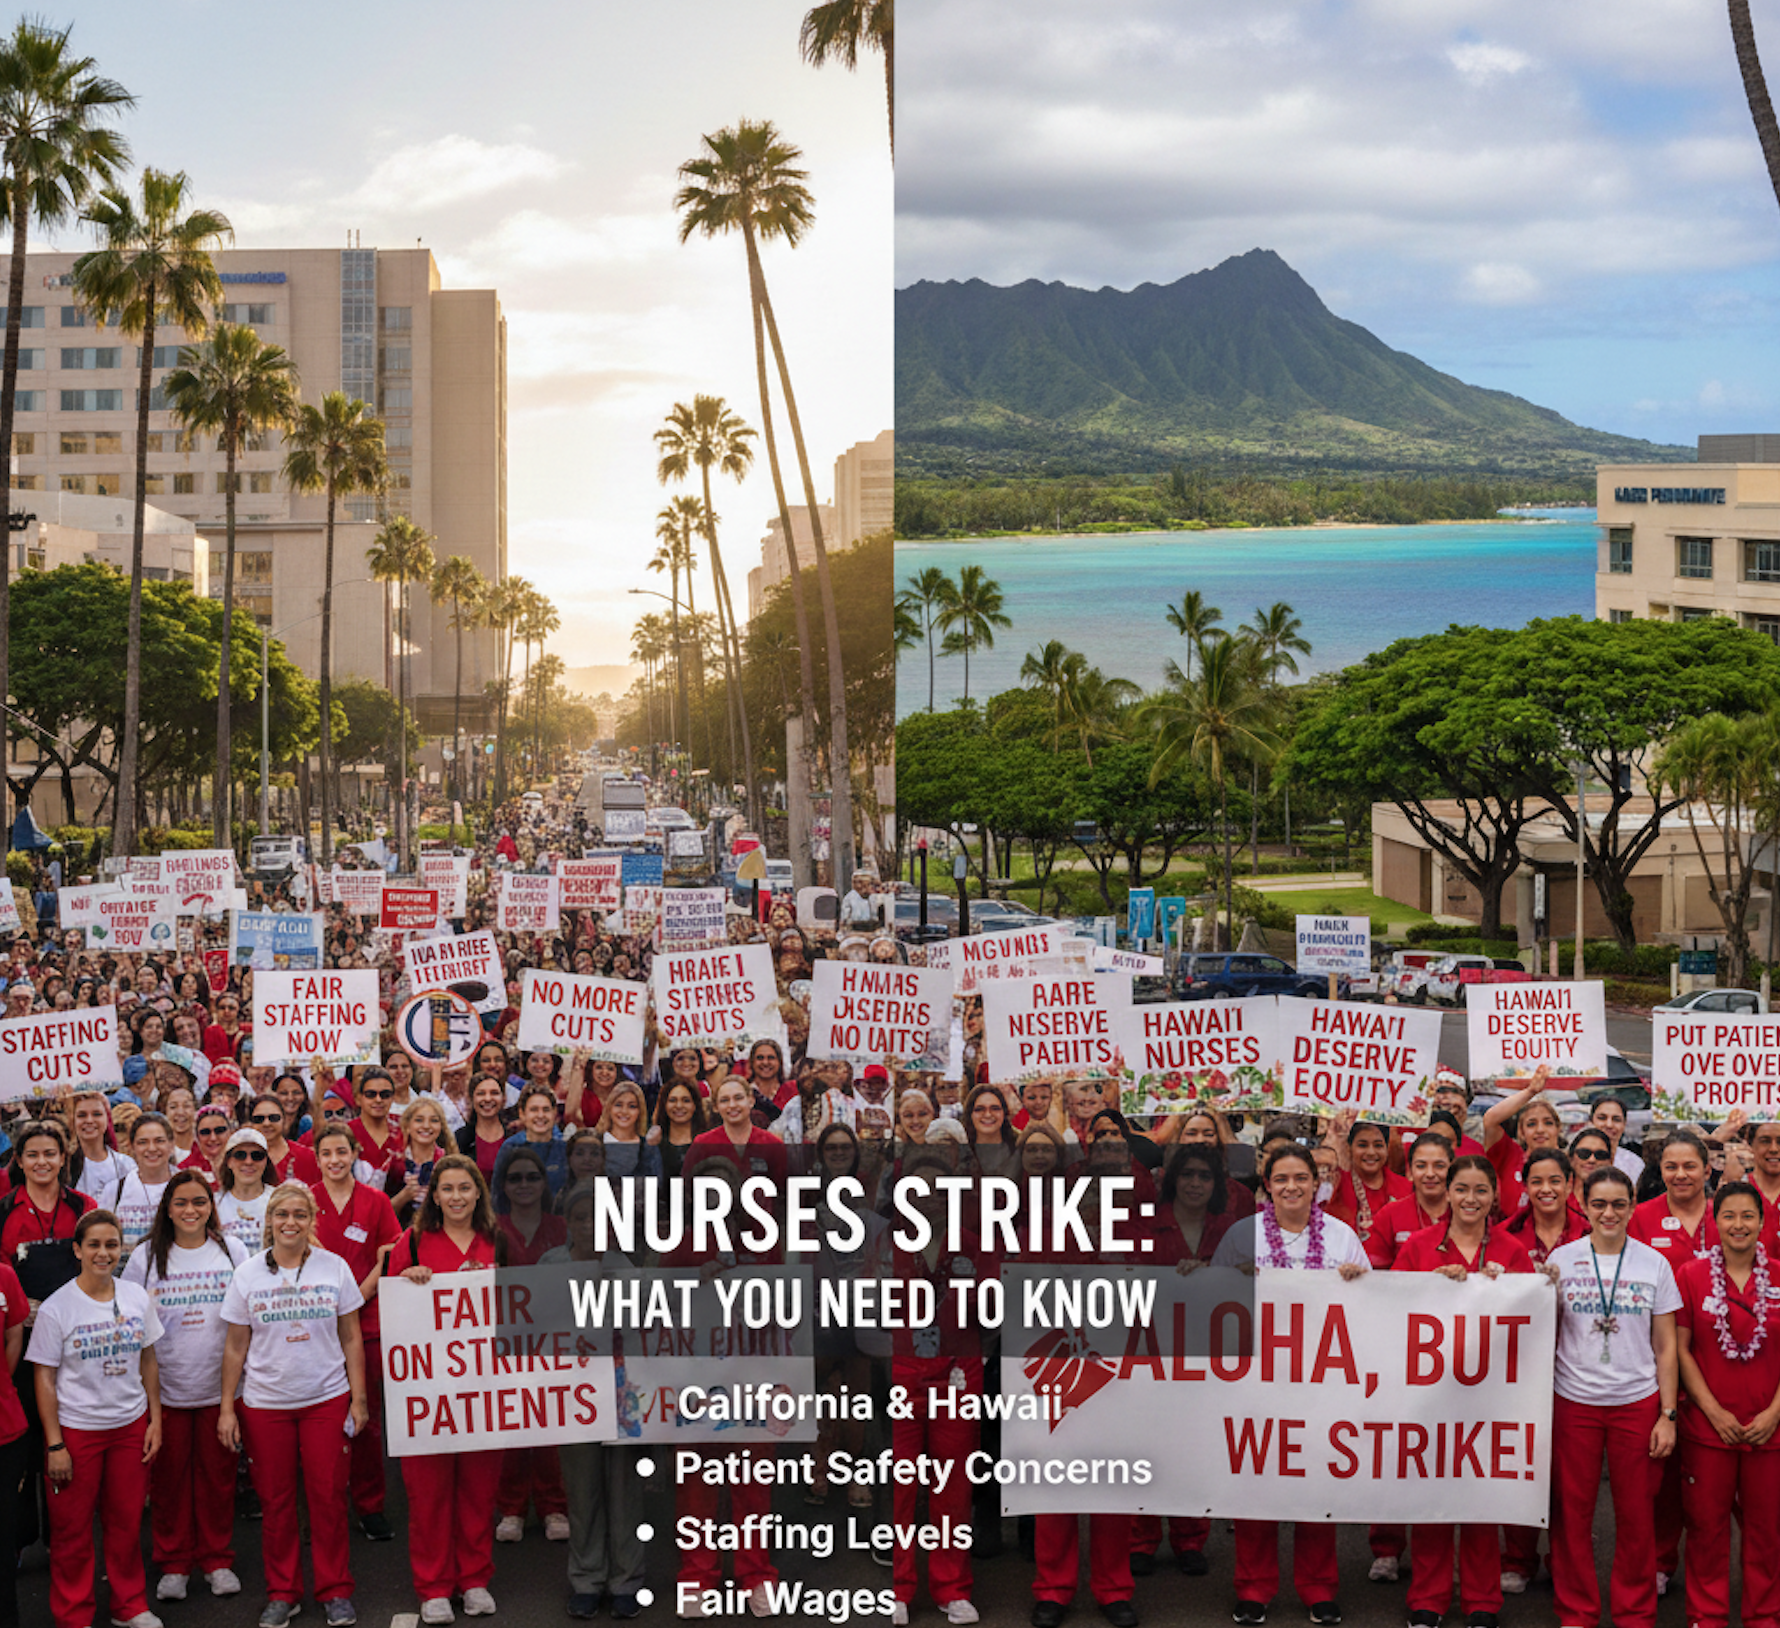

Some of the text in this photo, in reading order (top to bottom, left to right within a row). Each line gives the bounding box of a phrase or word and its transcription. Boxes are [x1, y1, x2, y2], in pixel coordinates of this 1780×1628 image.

[292, 976, 343, 1000] FAIR
[532, 979, 638, 1015] NO MORE
[264, 1002, 367, 1026] STAFFING
[551, 1013, 615, 1043] CUTS
[1488, 1013, 1584, 1035] DESERVE
[1, 1017, 109, 1054] STAFFING
[287, 1029, 342, 1053] NOW
[1667, 1024, 1707, 1046] PUT
[27, 1051, 91, 1082] CUTS
[1145, 1036, 1260, 1070] NURSES
[1293, 1036, 1417, 1075] DESERVE
[1681, 1052, 1780, 1076] OVE OVE
[1293, 1067, 1408, 1107] EQUITY
[388, 1343, 434, 1382] ON
[1118, 1301, 1531, 1398] ALOHA, BUT
[406, 1383, 598, 1438] PATIENTS
[1223, 1417, 1536, 1481] WE STRIKE!
